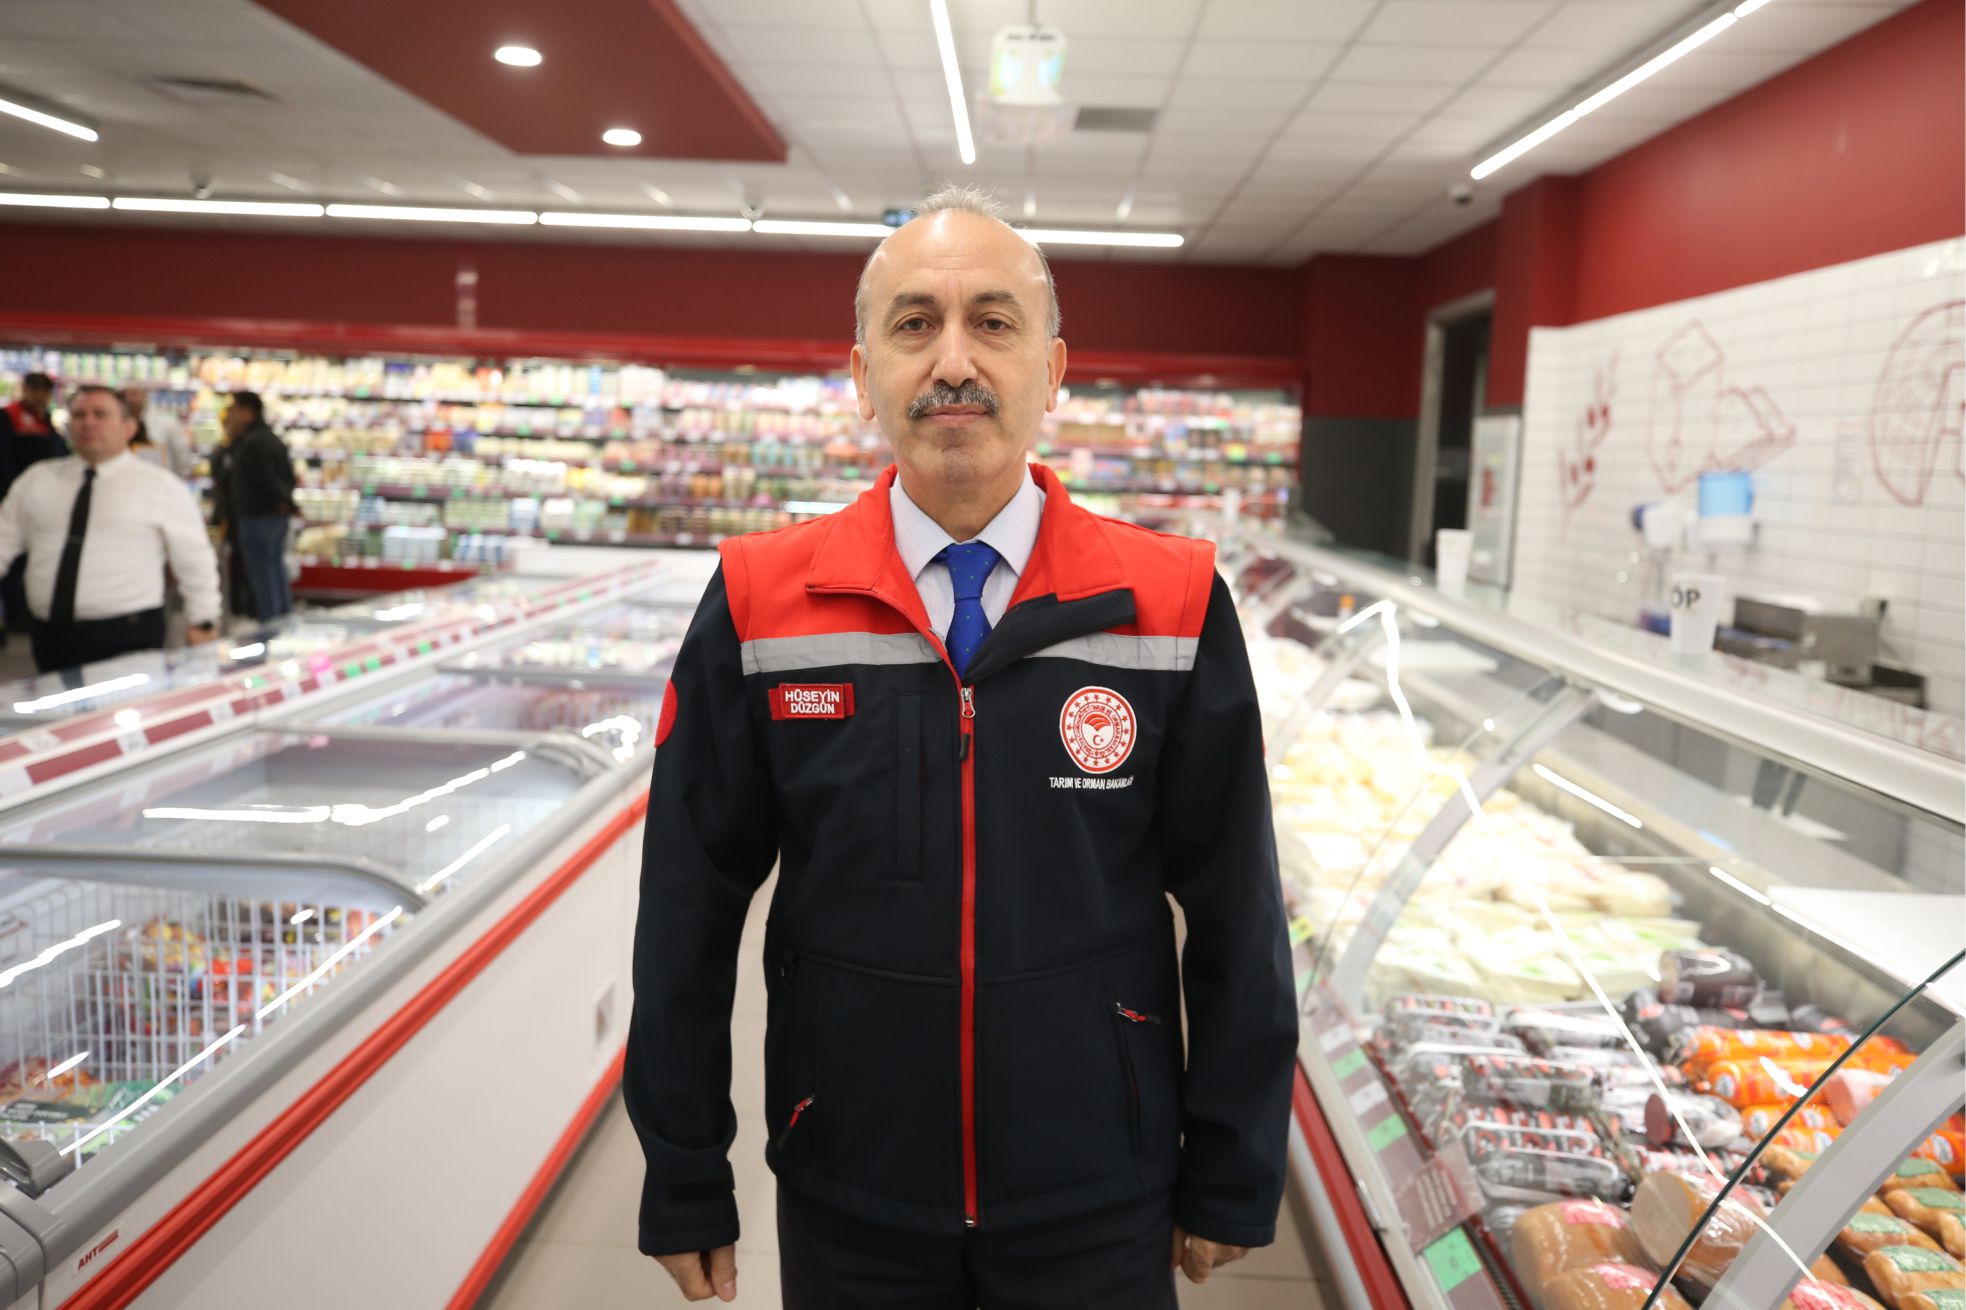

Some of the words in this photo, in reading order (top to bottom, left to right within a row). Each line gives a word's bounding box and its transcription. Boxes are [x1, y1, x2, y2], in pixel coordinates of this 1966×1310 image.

[790, 701, 835, 714] DÜZGÜN
[1049, 776, 1073, 789] TARIM
[1074, 777, 1082, 789] VE
[1082, 777, 1105, 790] ORMAN
[77, 1246, 98, 1271] AHT
